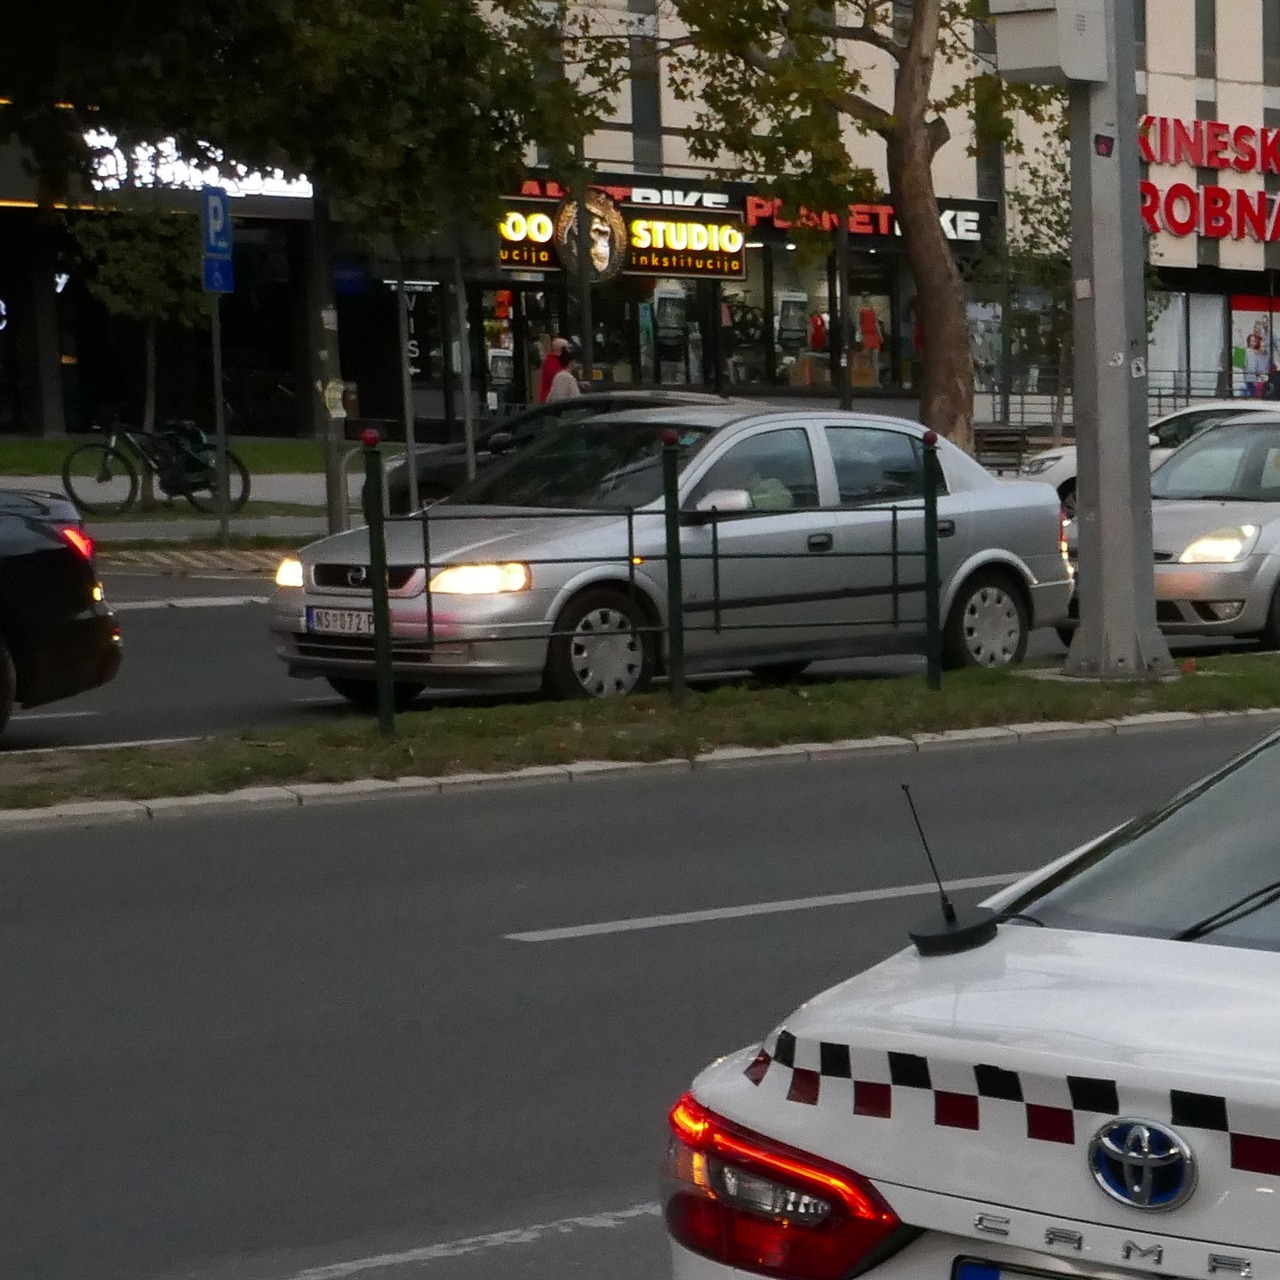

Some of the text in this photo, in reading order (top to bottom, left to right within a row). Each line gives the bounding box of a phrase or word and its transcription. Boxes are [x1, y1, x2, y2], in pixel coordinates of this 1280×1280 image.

[632, 219, 743, 252] STUDIO
[631, 252, 740, 272] inkstitucija
[315, 611, 331, 629] NS
